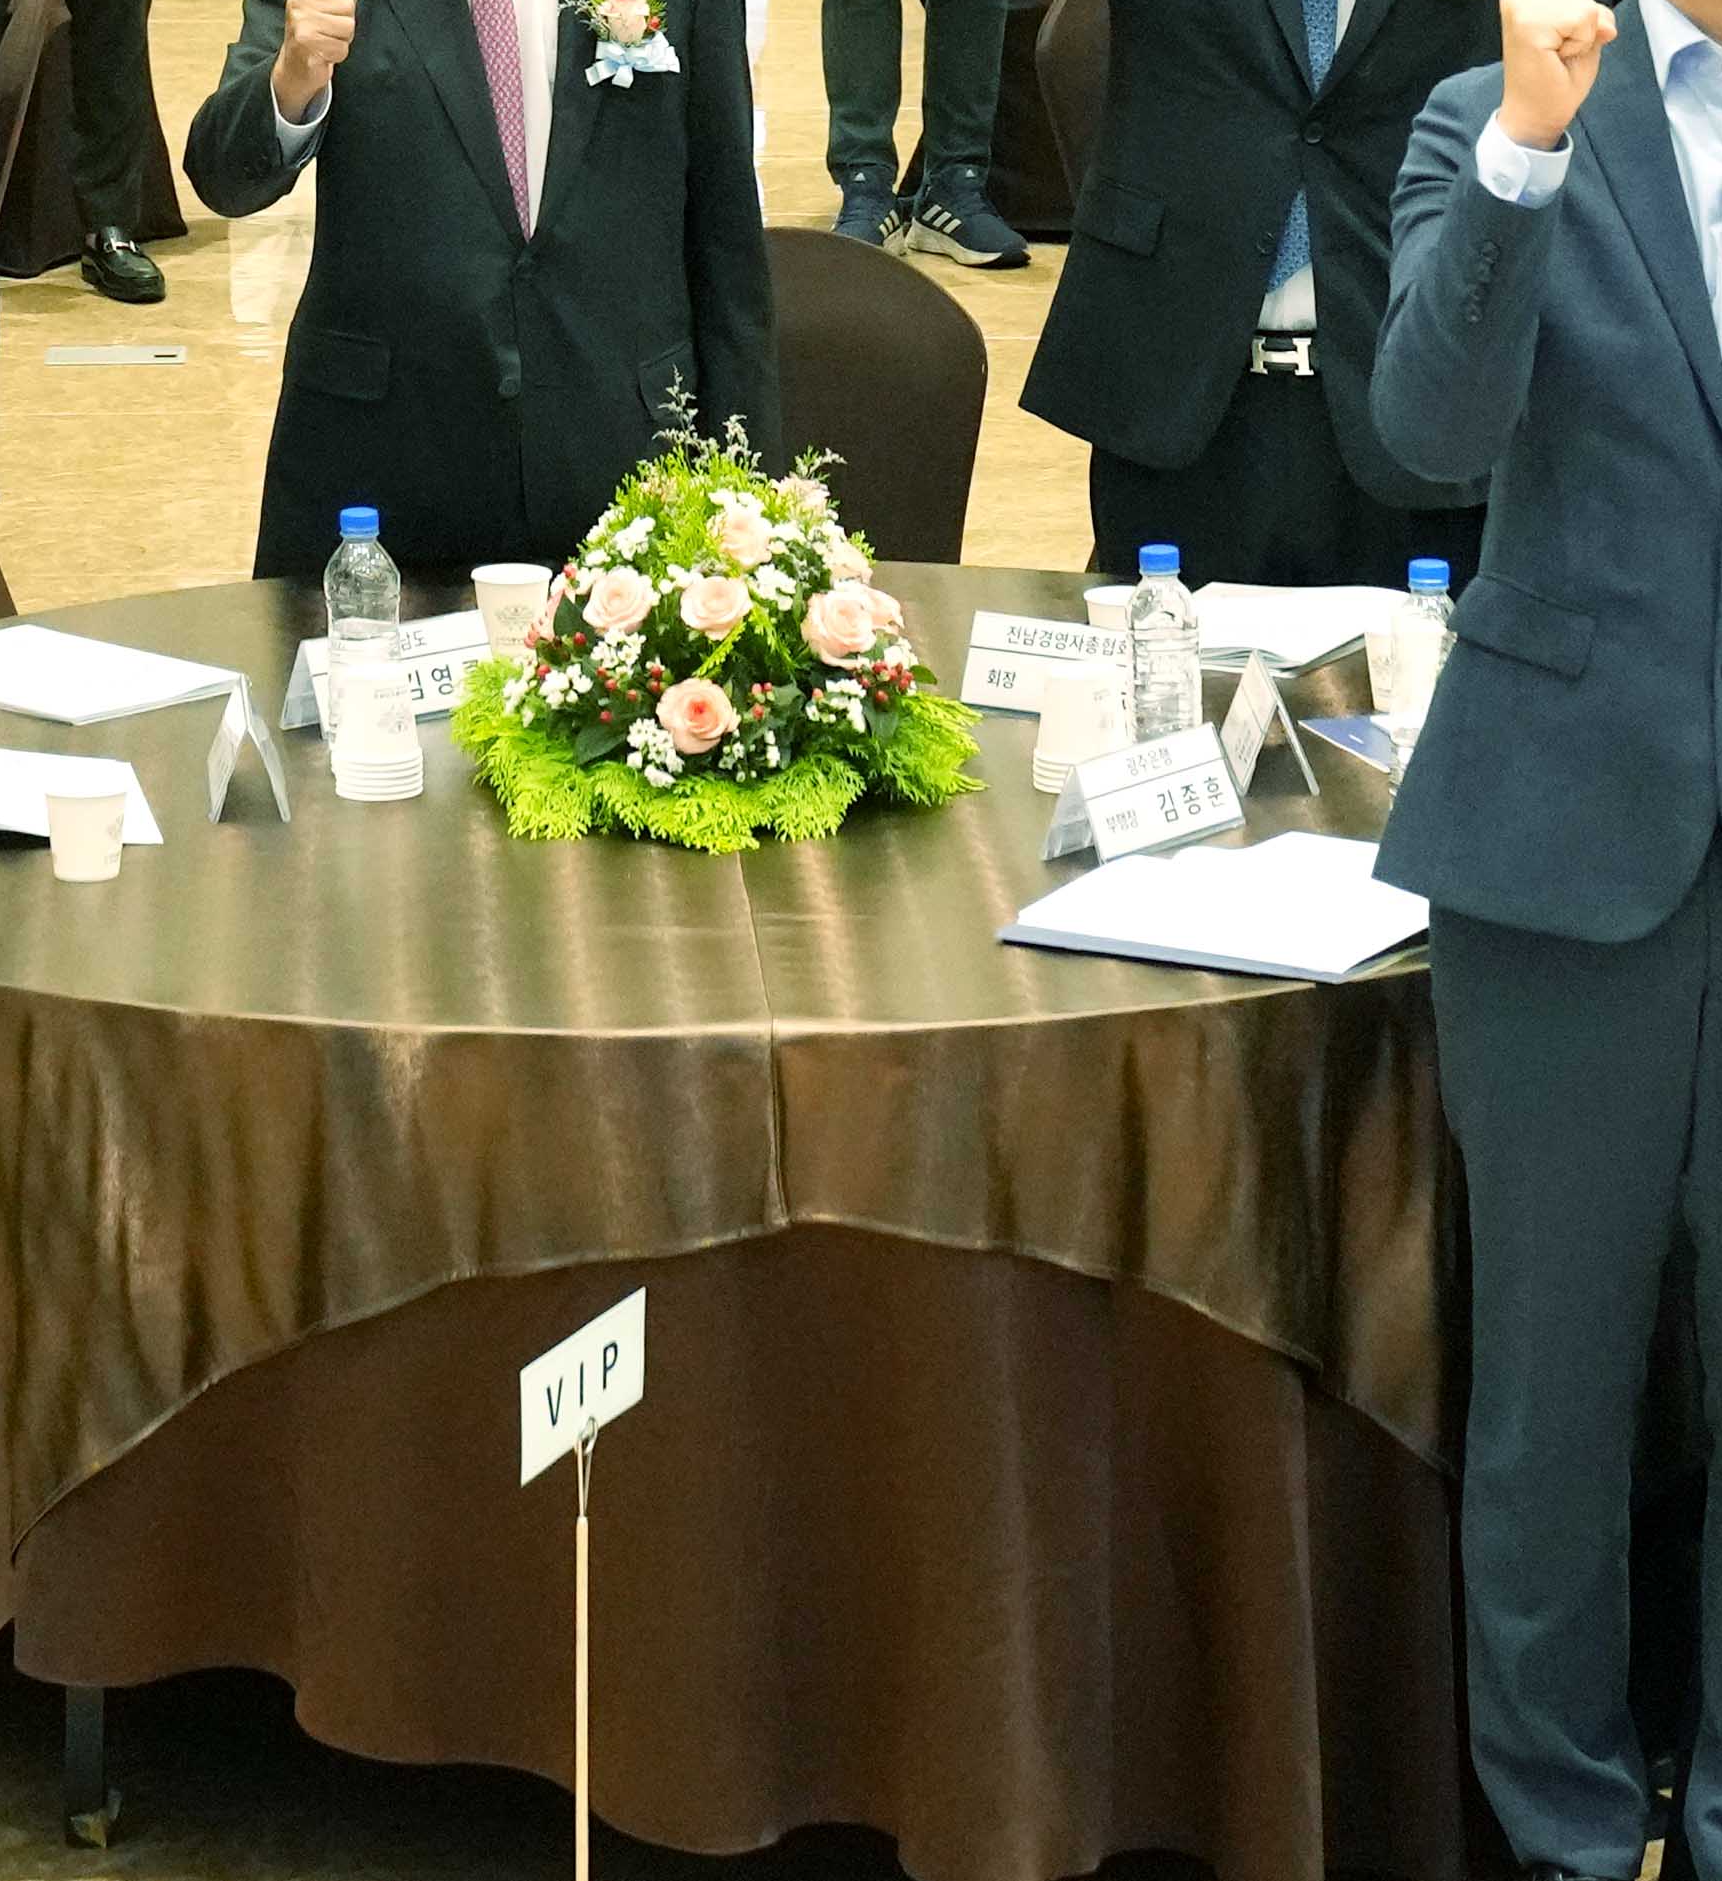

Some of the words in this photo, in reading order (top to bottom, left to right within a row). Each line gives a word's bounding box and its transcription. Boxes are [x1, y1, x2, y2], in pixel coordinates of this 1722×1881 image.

[400, 630, 428, 651] 남도
[986, 667, 1017, 690] 회장
[1125, 745, 1174, 778] 광주은행
[1156, 775, 1226, 824] 김종훈
[546, 1341, 619, 1427] VIP
